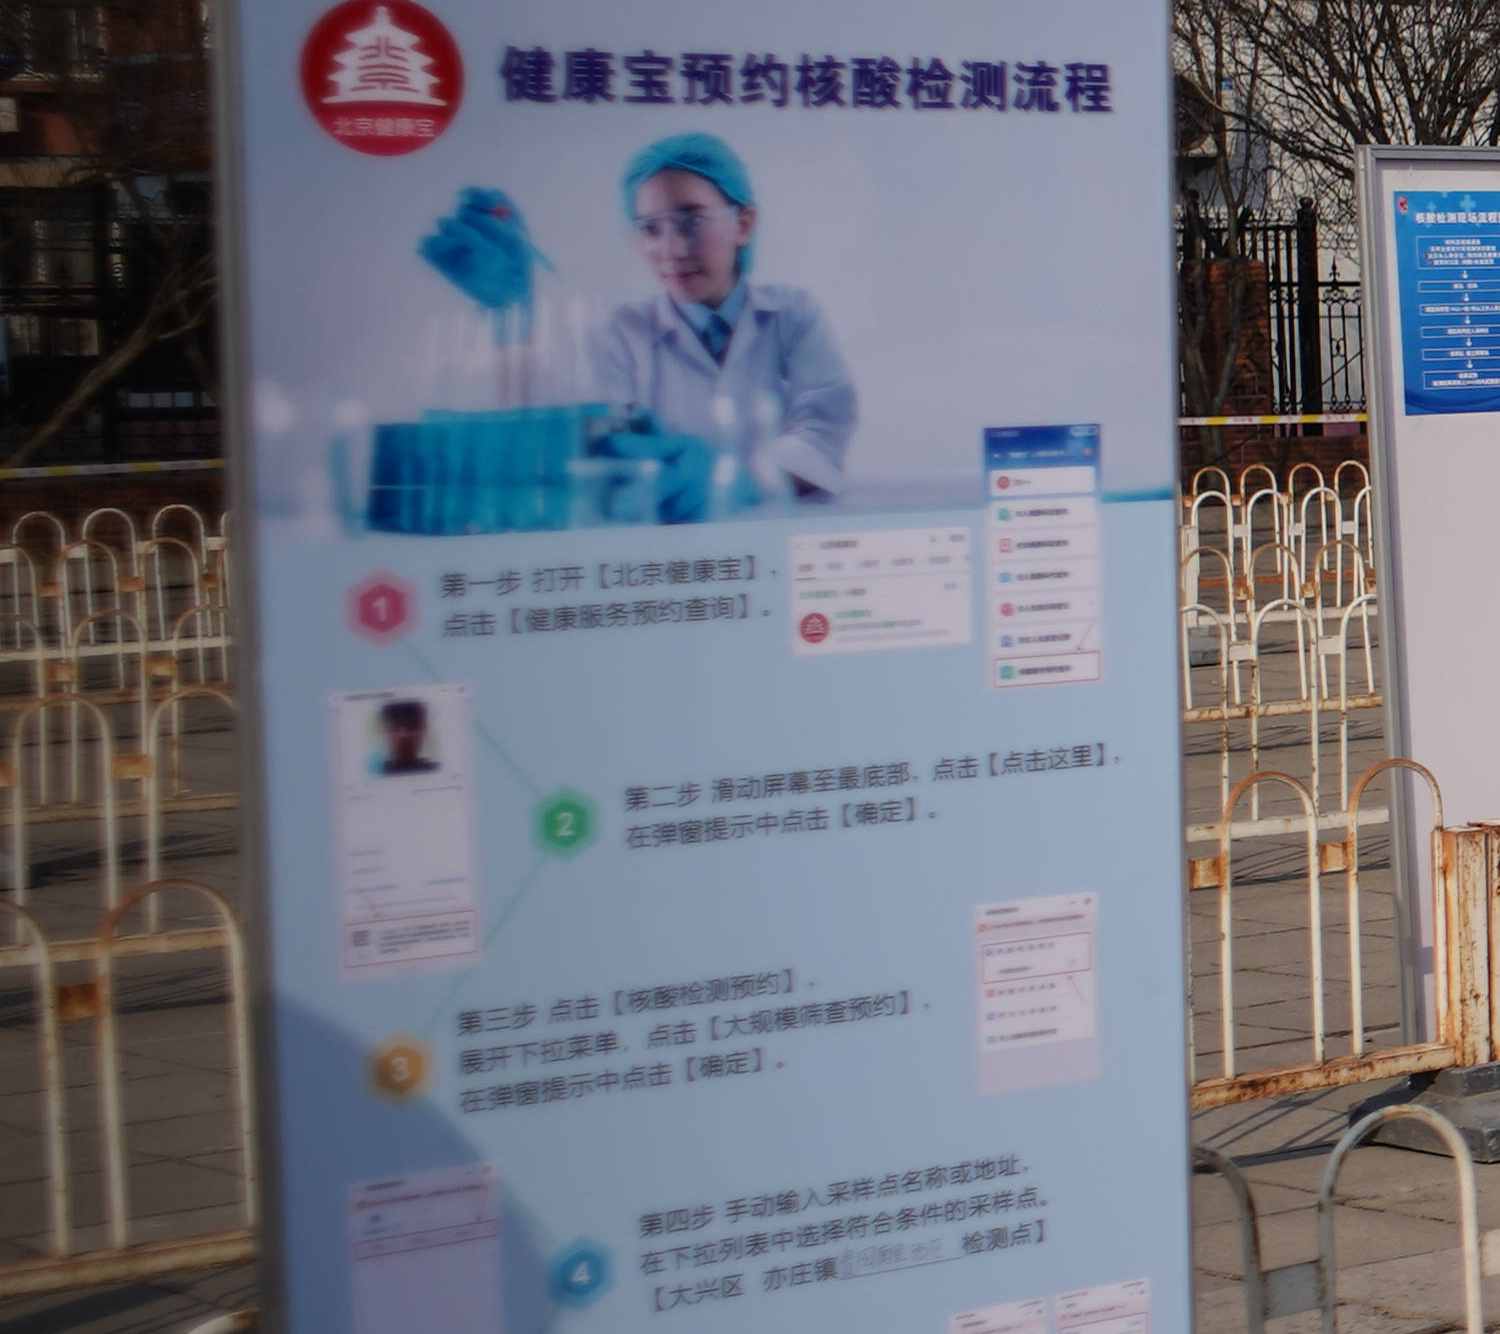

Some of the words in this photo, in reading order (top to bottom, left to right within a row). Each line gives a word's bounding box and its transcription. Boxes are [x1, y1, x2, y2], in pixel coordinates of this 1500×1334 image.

[497, 44, 1115, 116] 健康宝预约核酸检测流程
[333, 116, 436, 138] 北京健康宝
[440, 571, 523, 600] 第一步
[372, 596, 388, 623] 1
[624, 777, 702, 813] 第二步
[554, 813, 575, 838] 2
[456, 1001, 537, 1038] 第三步
[639, 1203, 716, 1240] 第四步
